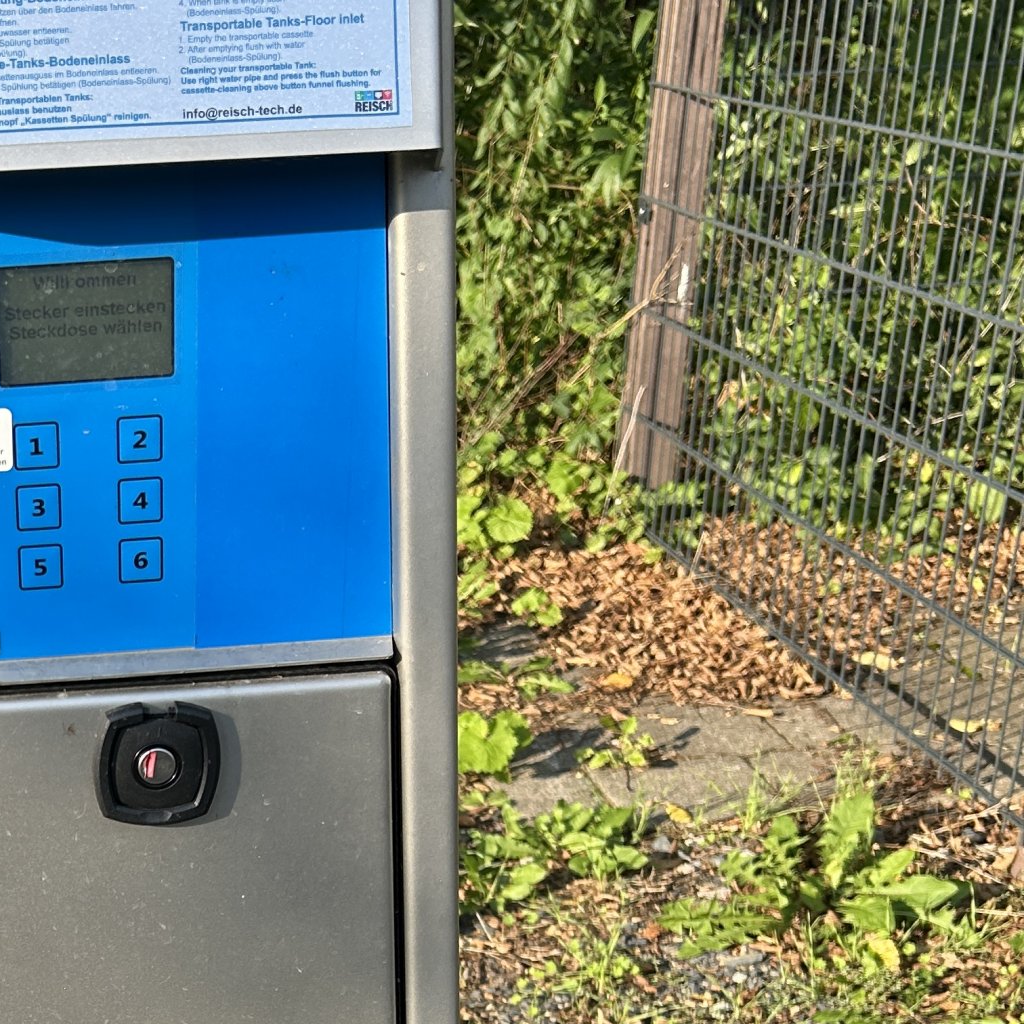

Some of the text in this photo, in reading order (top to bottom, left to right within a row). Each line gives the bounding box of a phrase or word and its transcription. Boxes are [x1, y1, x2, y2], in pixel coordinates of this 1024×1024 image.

[18, 7, 36, 15] über
[38, 6, 53, 14] den
[56, 4, 107, 13] Bodeneinlass
[180, 13, 364, 32] Transportable Tanks-Floor inlet
[0, 39, 31, 48] Spülung
[34, 37, 69, 46] betätigen
[188, 35, 212, 44] Empty
[215, 34, 227, 42] the
[229, 31, 279, 42] transportable
[281, 31, 313, 39] cassette
[188, 45, 205, 53] After
[208, 44, 243, 53] emptying
[246, 43, 263, 51] flush
[266, 41, 281, 49] with
[284, 41, 305, 49] water
[55, 70, 63, 78] im
[66, 68, 118, 78] Bodeneinlass
[180, 61, 316, 75] Cleaning your transportable Tank:
[181, 77, 196, 85] Use
[198, 76, 218, 85] right
[220, 75, 241, 83] water
[244, 74, 261, 83] pipe
[281, 72, 303, 80] press
[305, 71, 318, 79] the
[320, 70, 340, 78] flush
[342, 69, 368, 77] button
[370, 68, 382, 76] for
[1, 83, 38, 92] Spühlung
[40, 80, 76, 90] betätigen
[181, 79, 371, 95] cassette-cleaning above button funnel flushing.
[64, 92, 94, 101] Tanks:
[32, 105, 72, 114] benutzen
[182, 104, 303, 120] info@reisch-tech.de
[355, 101, 392, 112] REISCH
[114, 111, 151, 121] reinigen.
[5, 302, 166, 321] Stecker einstecken
[10, 320, 162, 340] Steckdose wählen
[29, 438, 44, 456] 1
[132, 430, 147, 449] 2
[32, 499, 46, 517] 3
[132, 492, 148, 510] 4
[34, 558, 48, 576] 5
[133, 552, 149, 569] 6
